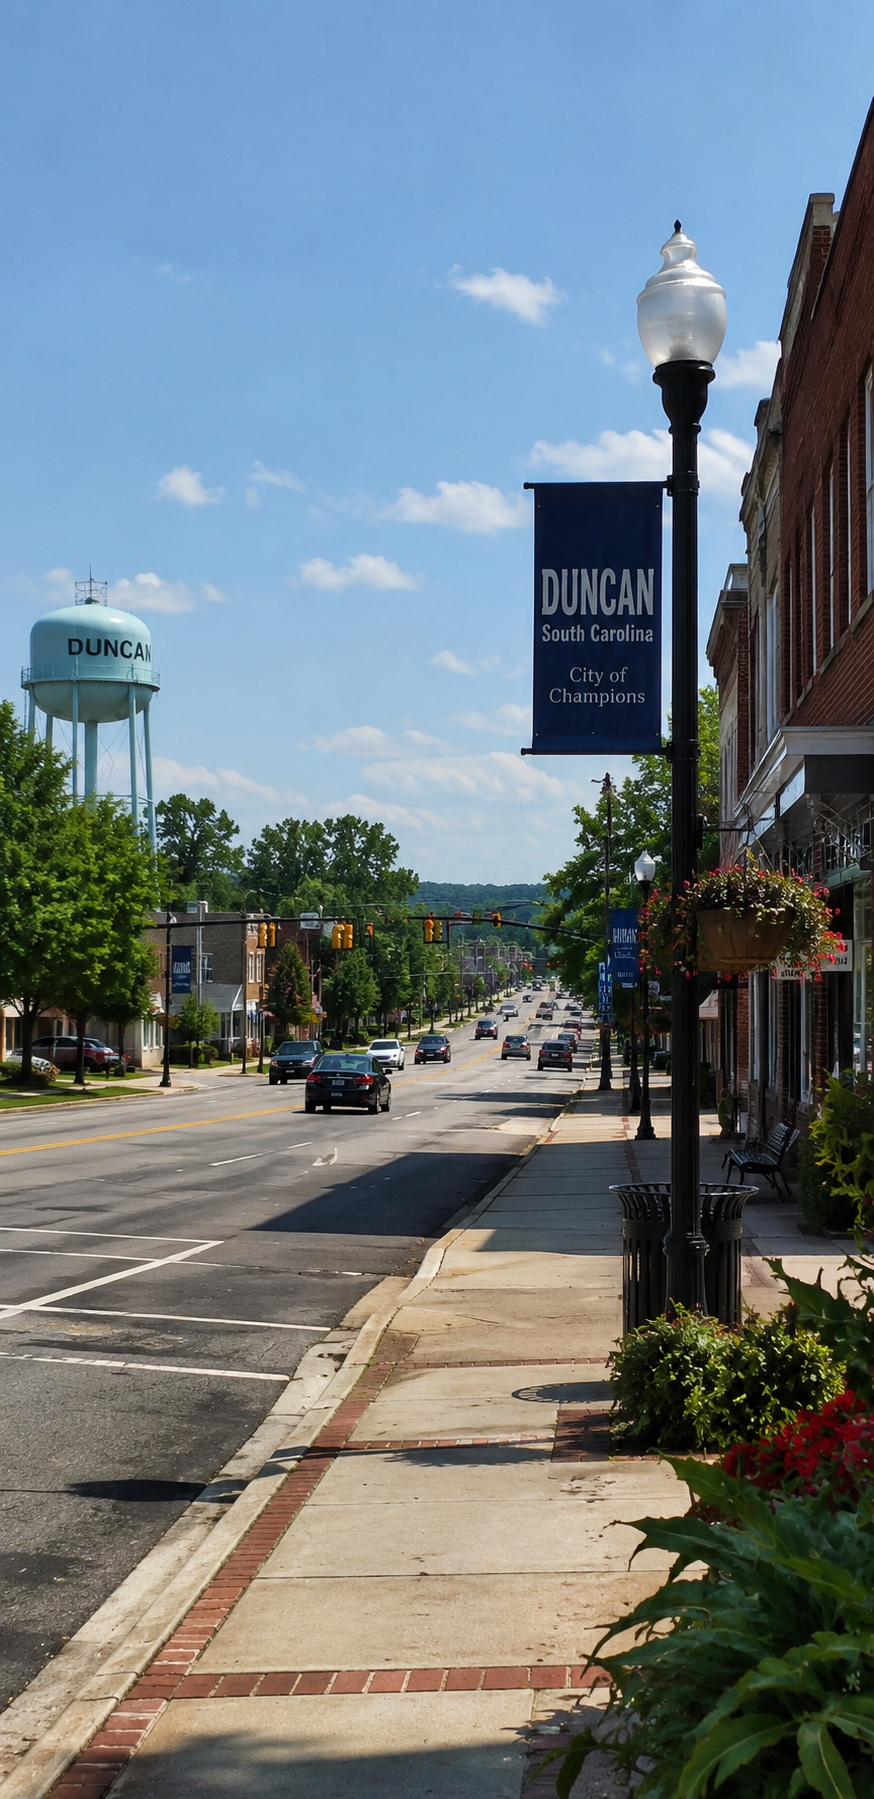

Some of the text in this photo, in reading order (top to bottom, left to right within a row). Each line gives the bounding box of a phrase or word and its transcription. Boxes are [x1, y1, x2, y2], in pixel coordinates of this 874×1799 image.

[541, 567, 655, 616] DUNCAN
[542, 624, 654, 643] South Carolina
[68, 638, 151, 662] DUNCAN
[569, 666, 628, 686] City of
[549, 687, 646, 708] Champions
